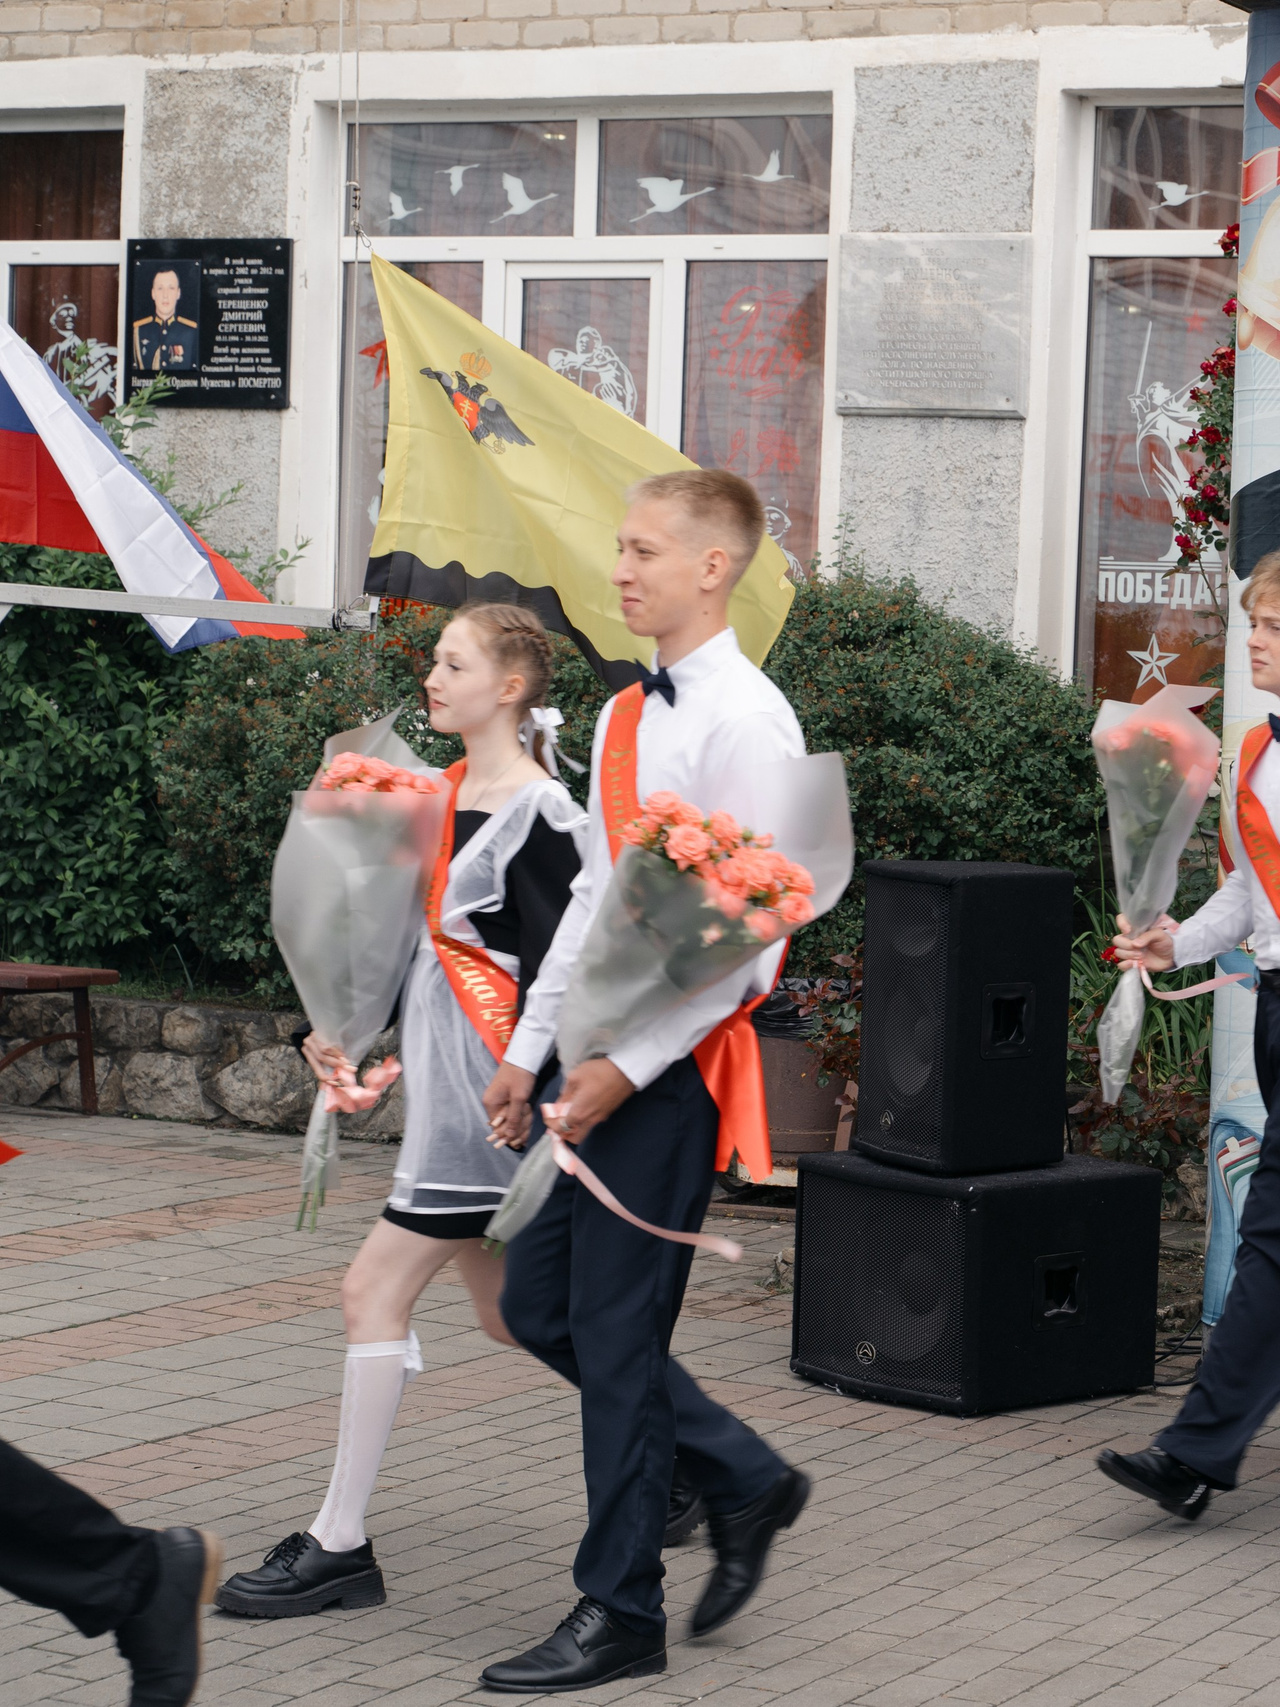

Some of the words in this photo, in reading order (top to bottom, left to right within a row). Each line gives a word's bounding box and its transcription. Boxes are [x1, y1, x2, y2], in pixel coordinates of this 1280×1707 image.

[217, 300, 268, 310] ТЕРЕЩЕНКО
[221, 310, 263, 321] ДМИТРИЙ
[720, 285, 764, 349] 9
[218, 323, 266, 333] СЕРГЕЕВИЧ
[717, 344, 806, 382] мая
[238, 377, 282, 388] ПОСМЕРТНО
[1098, 571, 1222, 610] ПОБЕДА!
